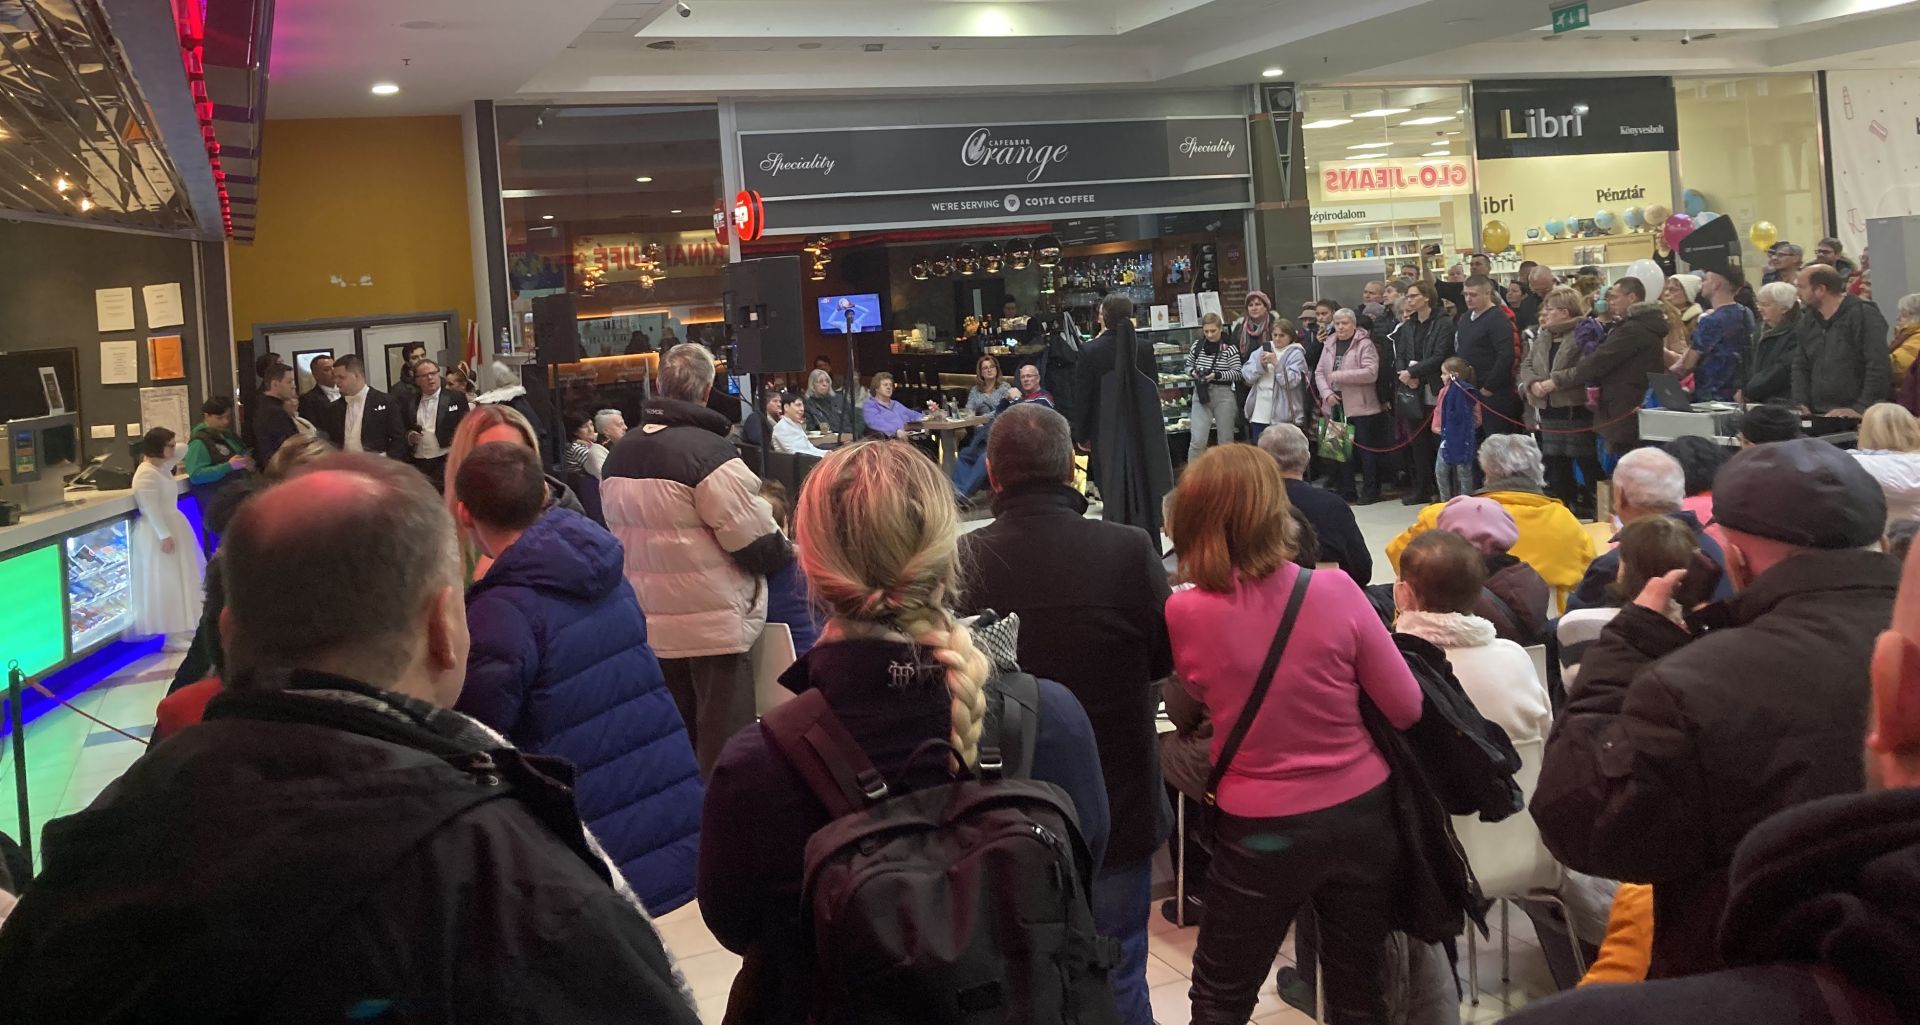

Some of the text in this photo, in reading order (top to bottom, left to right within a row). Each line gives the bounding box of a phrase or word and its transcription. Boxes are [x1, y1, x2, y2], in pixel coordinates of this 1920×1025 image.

[1501, 107, 1583, 139] Libri
[1620, 124, 1665, 136] Könyvesbolt
[961, 127, 1069, 183] Orange
[1180, 136, 1236, 158] Speciality
[760, 152, 836, 176] Speciality
[1025, 194, 1095, 206] COSTA COFFEE
[1596, 185, 1646, 202] Pénztár
[931, 199, 1000, 211] WE'RE SERVING
[1481, 194, 1514, 215] ibri
